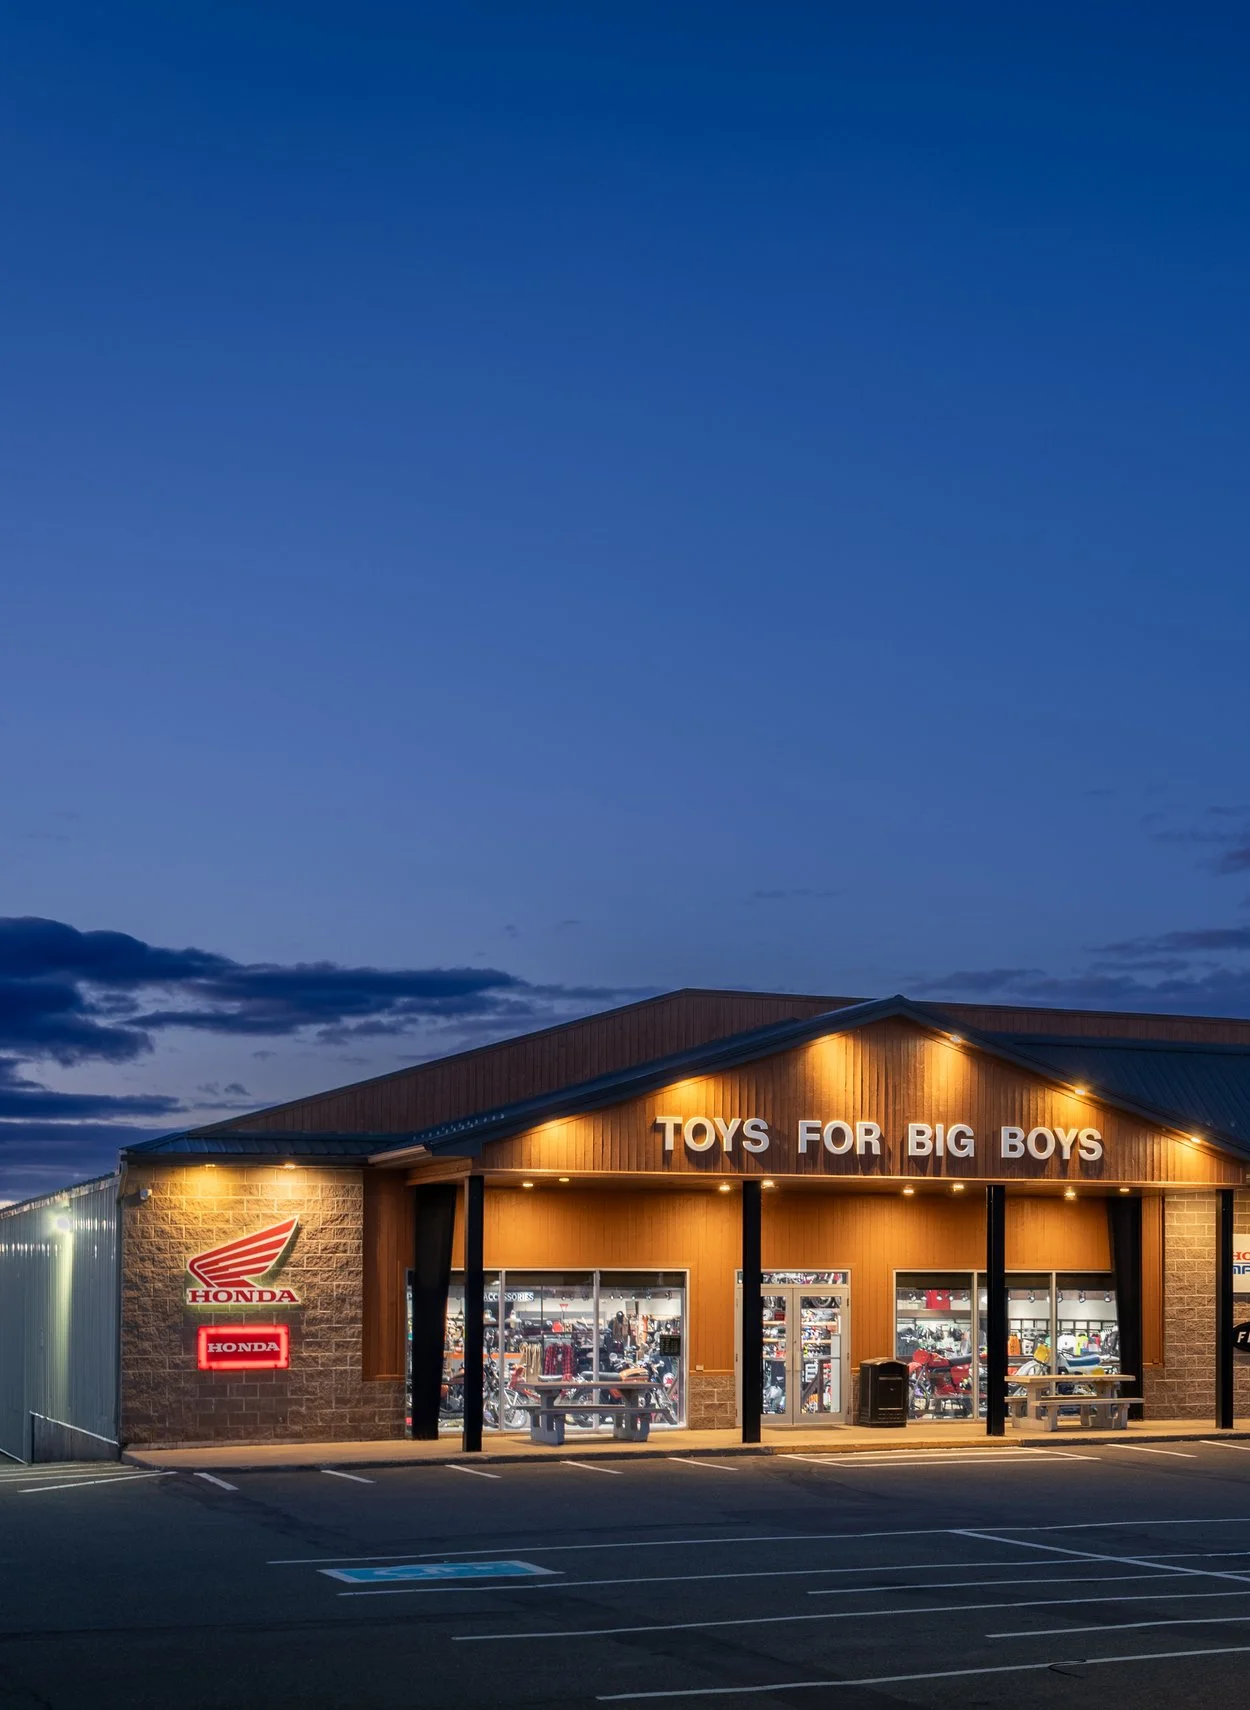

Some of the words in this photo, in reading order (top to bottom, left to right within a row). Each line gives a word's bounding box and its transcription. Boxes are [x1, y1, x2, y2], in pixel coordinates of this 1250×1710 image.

[656, 1116, 770, 1154] TOYS
[797, 1119, 881, 1156] FOR
[907, 1122, 975, 1157] BIG
[1000, 1125, 1104, 1162] BOYS
[188, 1289, 300, 1303] HONDA
[483, 1291, 535, 1302] ACCSSORIES
[207, 1342, 281, 1353] HONDA
